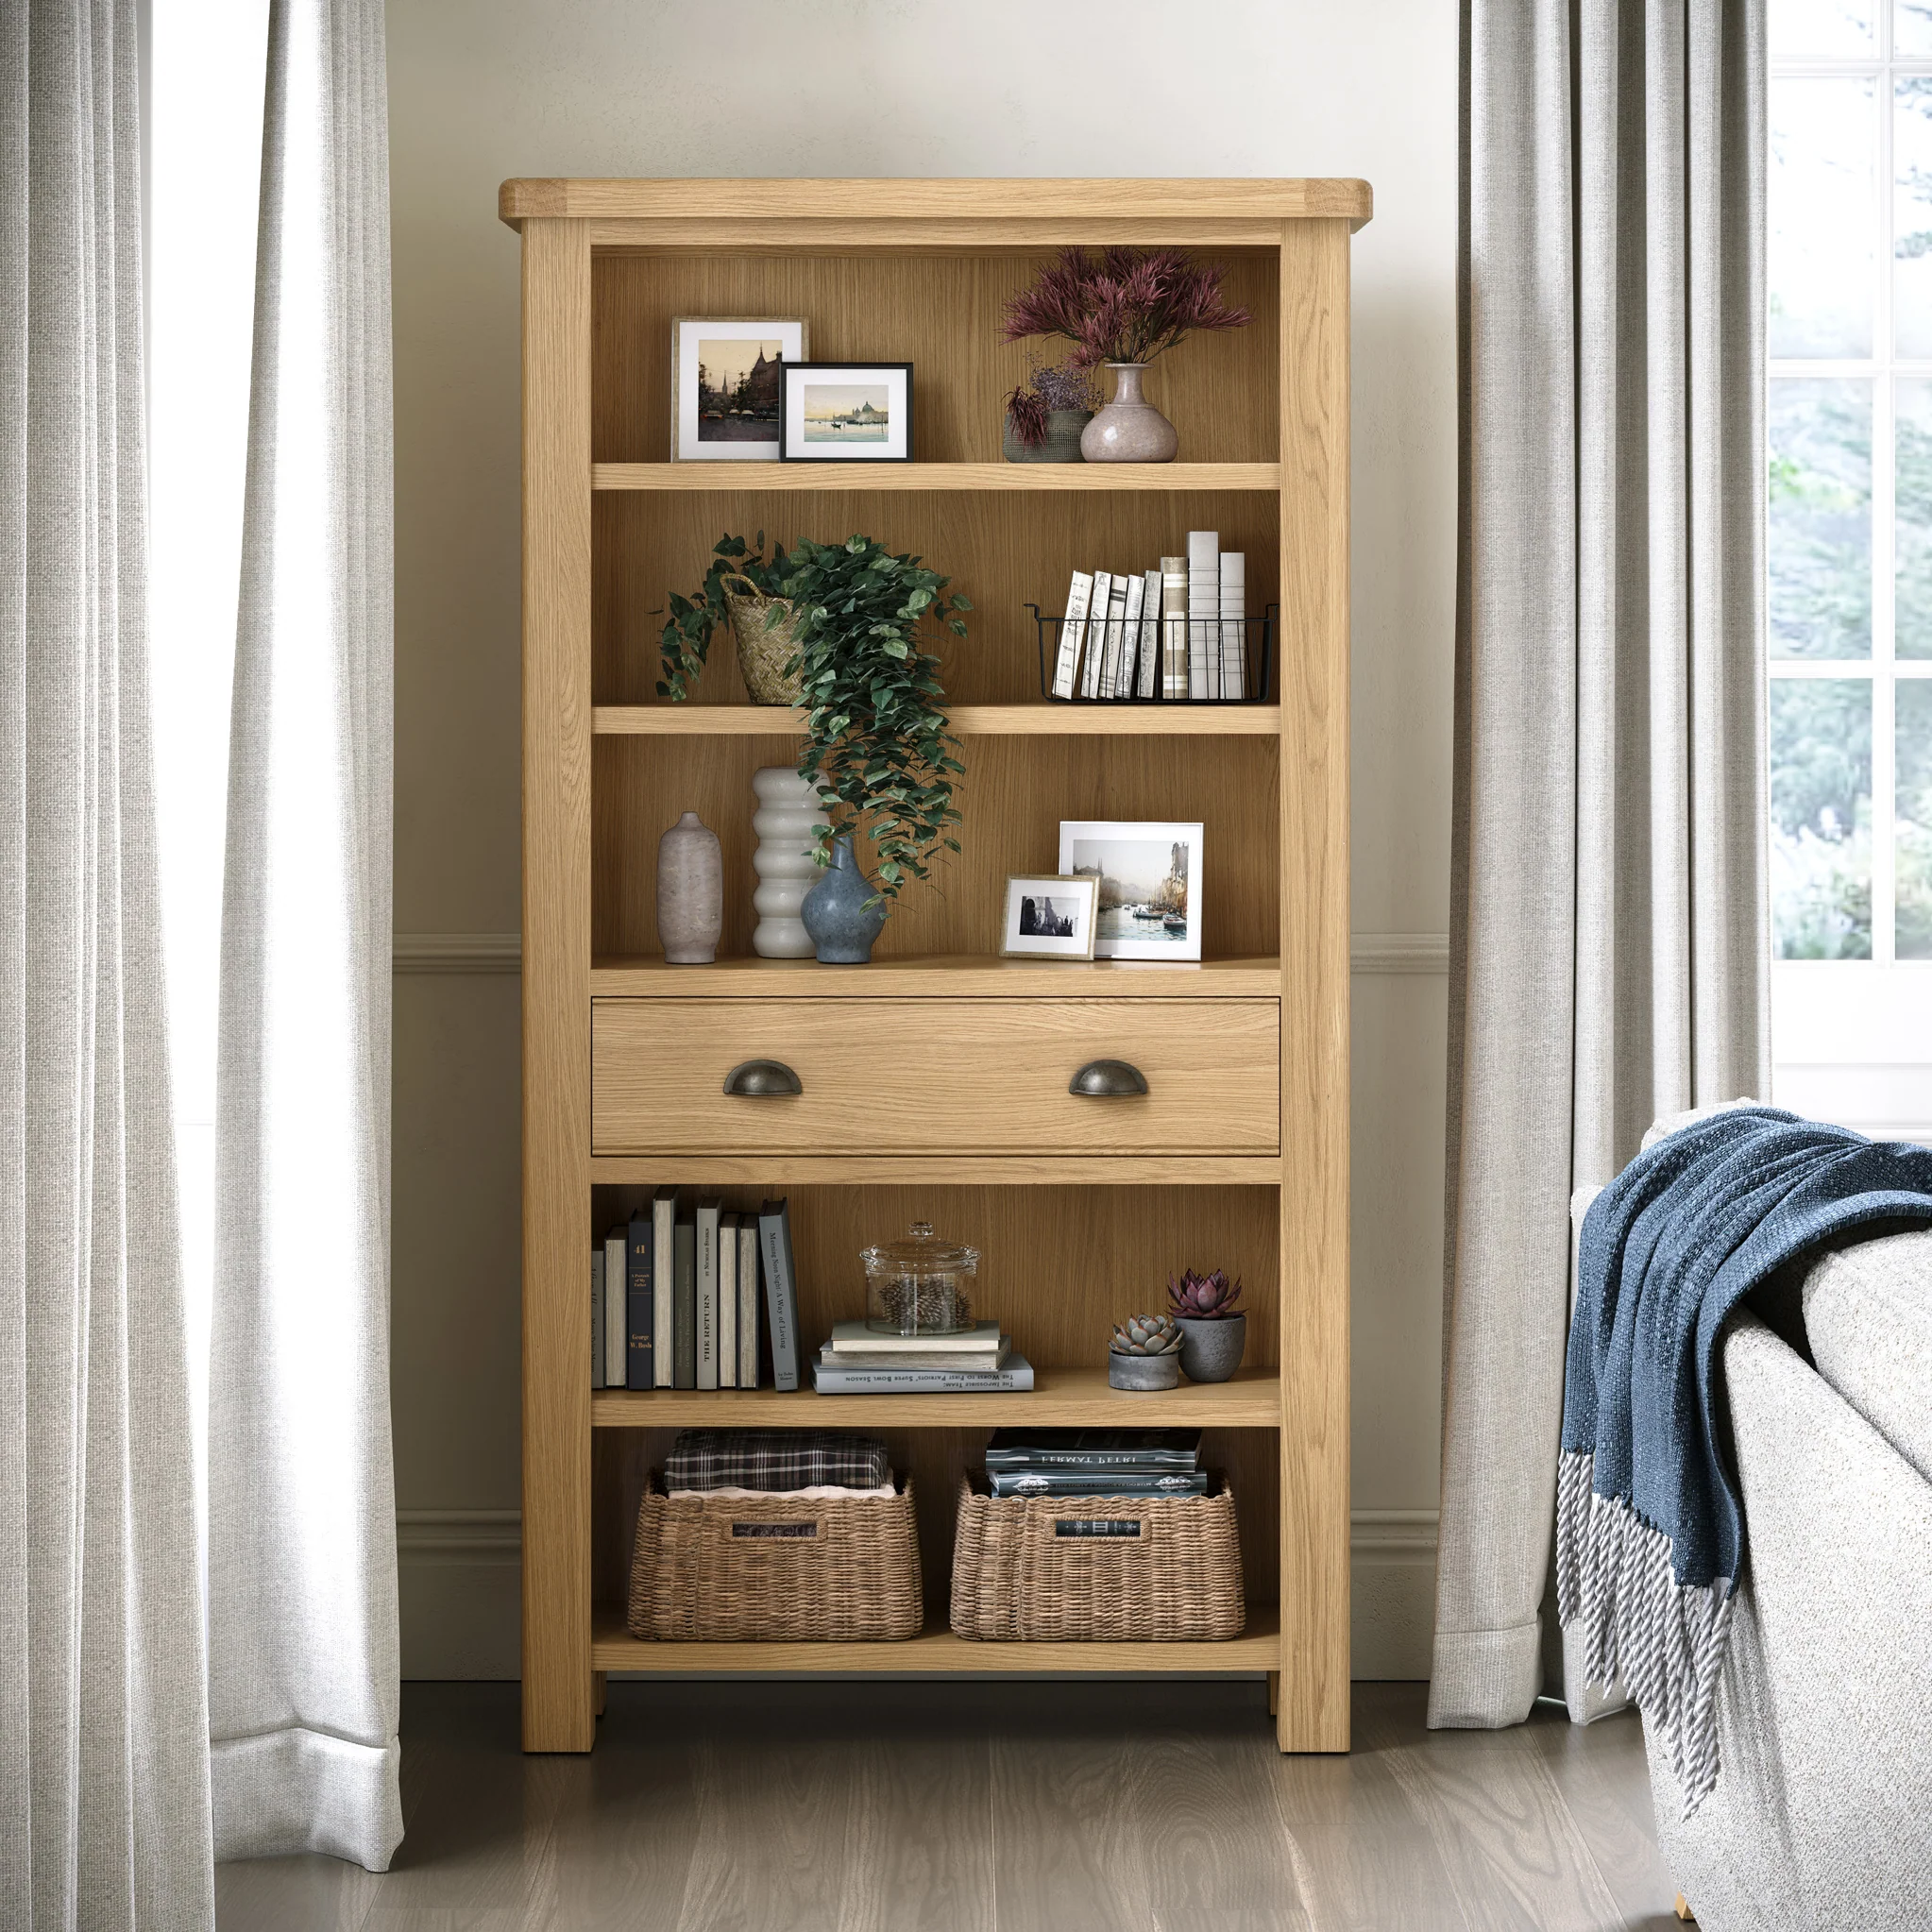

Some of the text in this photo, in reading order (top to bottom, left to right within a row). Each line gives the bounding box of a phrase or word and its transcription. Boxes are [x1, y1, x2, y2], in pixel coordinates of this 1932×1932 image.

[634, 1245, 646, 1254] 41
[769, 1232, 779, 1259] Morning
[771, 1259, 780, 1274] Noon
[776, 1298, 785, 1314] Way
[779, 1326, 788, 1349] Living
